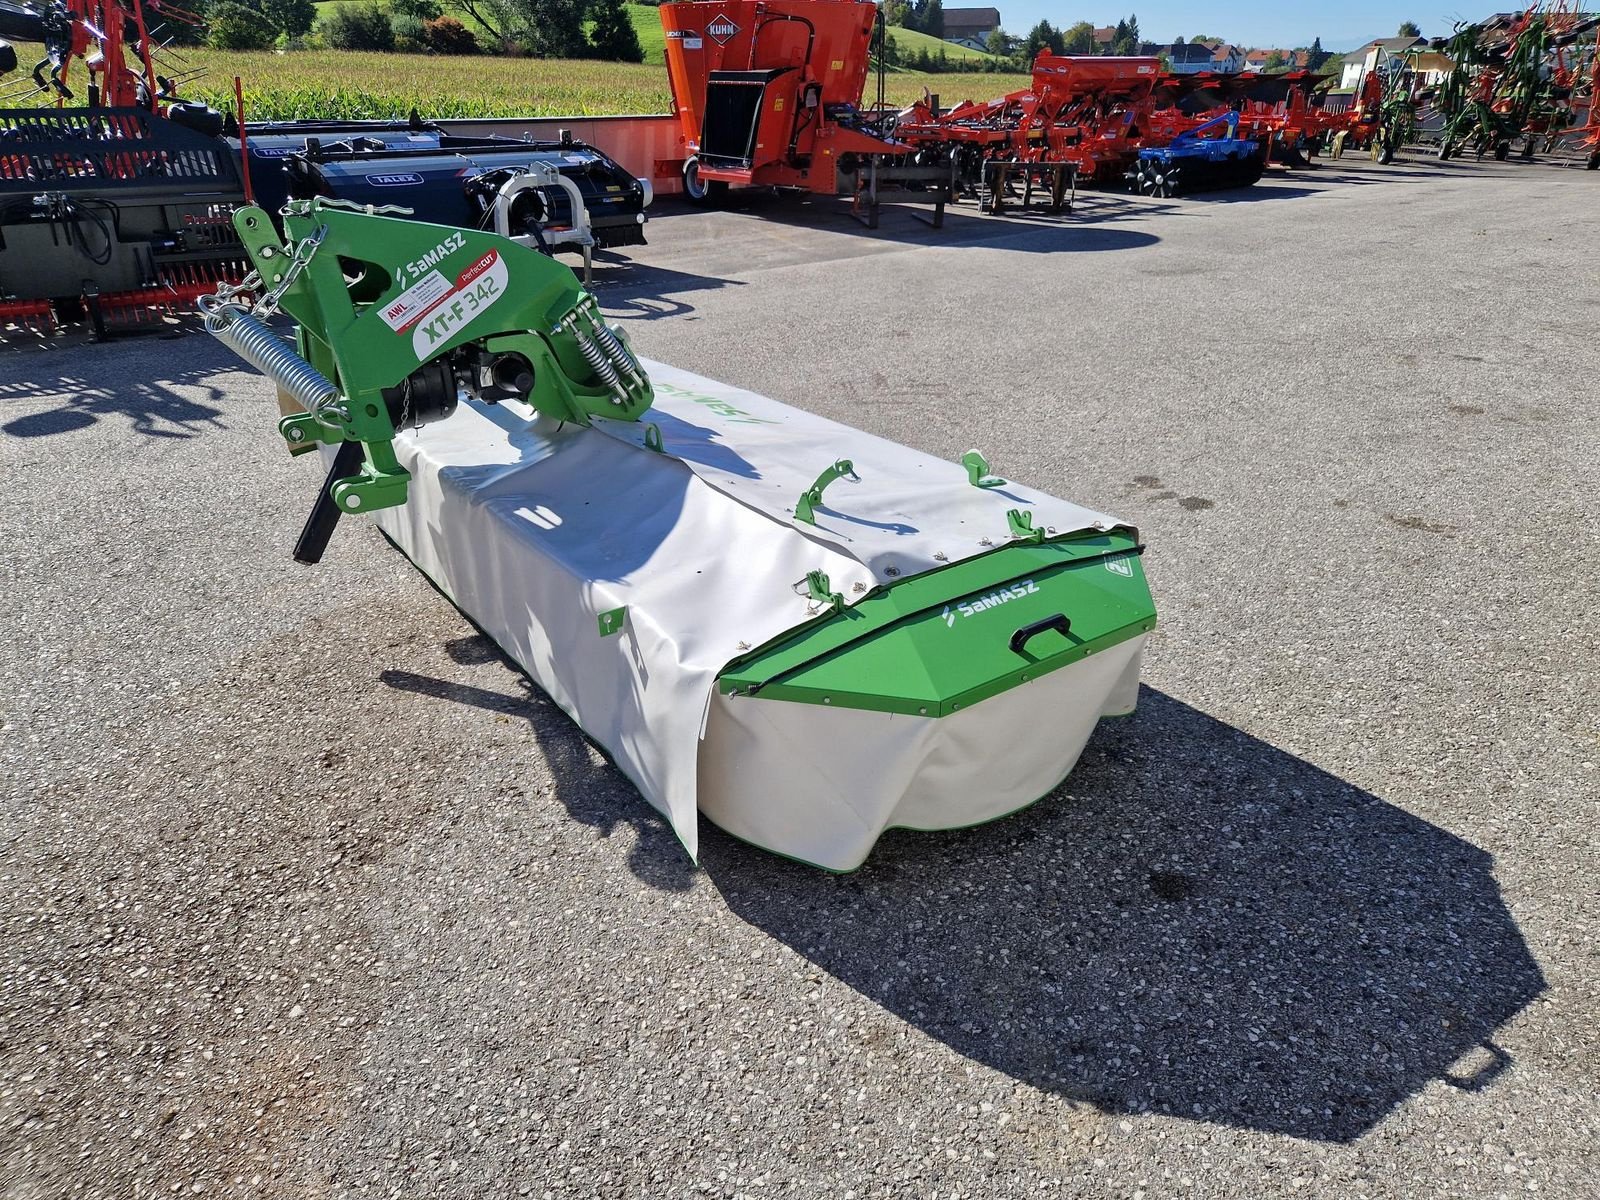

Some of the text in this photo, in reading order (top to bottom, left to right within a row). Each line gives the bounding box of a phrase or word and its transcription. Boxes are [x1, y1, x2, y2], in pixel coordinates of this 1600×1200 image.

[709, 24, 734, 35] KUHN
[371, 175, 417, 184] TALEX
[406, 231, 467, 279] SaMASZ
[461, 253, 494, 282] PerfectCUT
[387, 302, 408, 320] AWL
[421, 299, 465, 345] XT-F
[463, 275, 500, 312] 342
[957, 579, 1040, 618] SaMASZ
